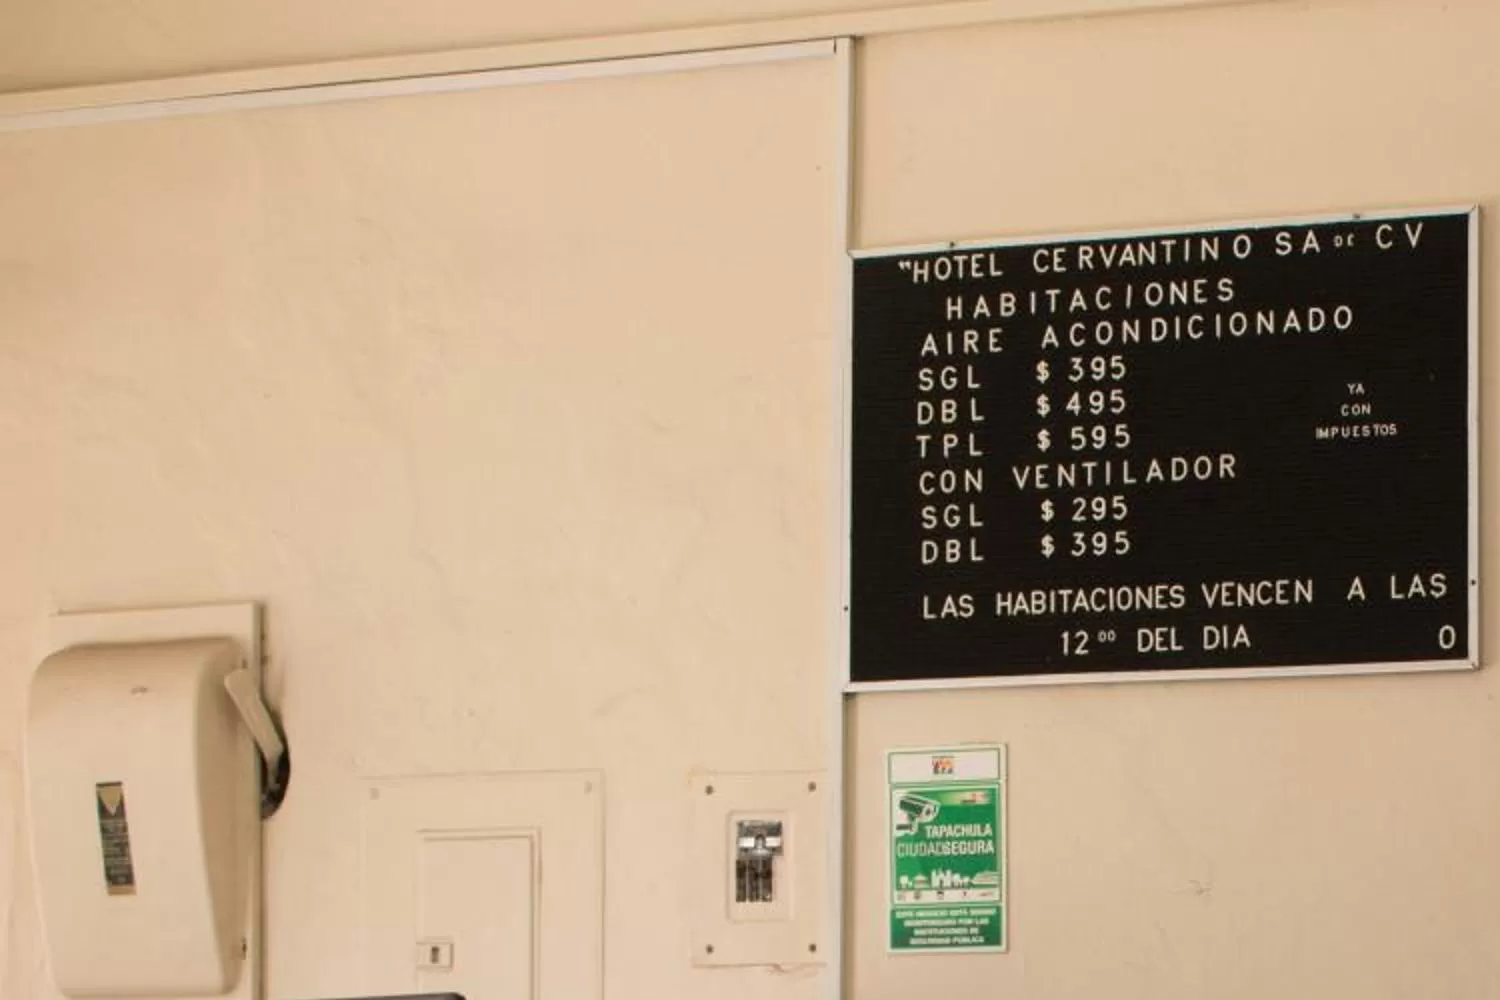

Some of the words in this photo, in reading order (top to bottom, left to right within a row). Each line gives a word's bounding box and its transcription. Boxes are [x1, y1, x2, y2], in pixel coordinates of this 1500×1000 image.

[1275, 229, 1320, 256] SA
[946, 277, 1234, 320] HABITACIONES
[921, 327, 1002, 356] AIRE
[1041, 304, 1353, 349] ACONDICIONADO
[918, 365, 980, 391] SGL
[1036, 360, 1050, 384] $
[1068, 355, 1126, 382] 395
[1347, 383, 1365, 394] YA
[917, 397, 984, 425] DBL
[1036, 393, 1051, 417] $
[1065, 389, 1126, 416] 495
[1341, 404, 1371, 417] CON
[916, 433, 983, 458] TPL
[1037, 429, 1051, 452] $
[1071, 423, 1130, 451] 595
[1315, 423, 1397, 439] IMPUESTOS
[919, 469, 983, 496] CON
[1012, 454, 1236, 489] VENTILADOR
[921, 503, 983, 529] SGL
[1041, 499, 1055, 522] $
[1071, 495, 1127, 522] 295
[921, 538, 984, 565] DBL
[1041, 534, 1055, 558] $
[1071, 530, 1130, 557] 395
[923, 594, 975, 619] LAS
[996, 585, 1185, 616] HABITACIONES
[1201, 579, 1313, 608] VENCEN
[1347, 576, 1365, 600] A
[1391, 573, 1447, 599] LAS
[1137, 627, 1183, 653] DEL
[1203, 624, 1251, 650] DIA
[924, 823, 992, 838] TAPACHULA
